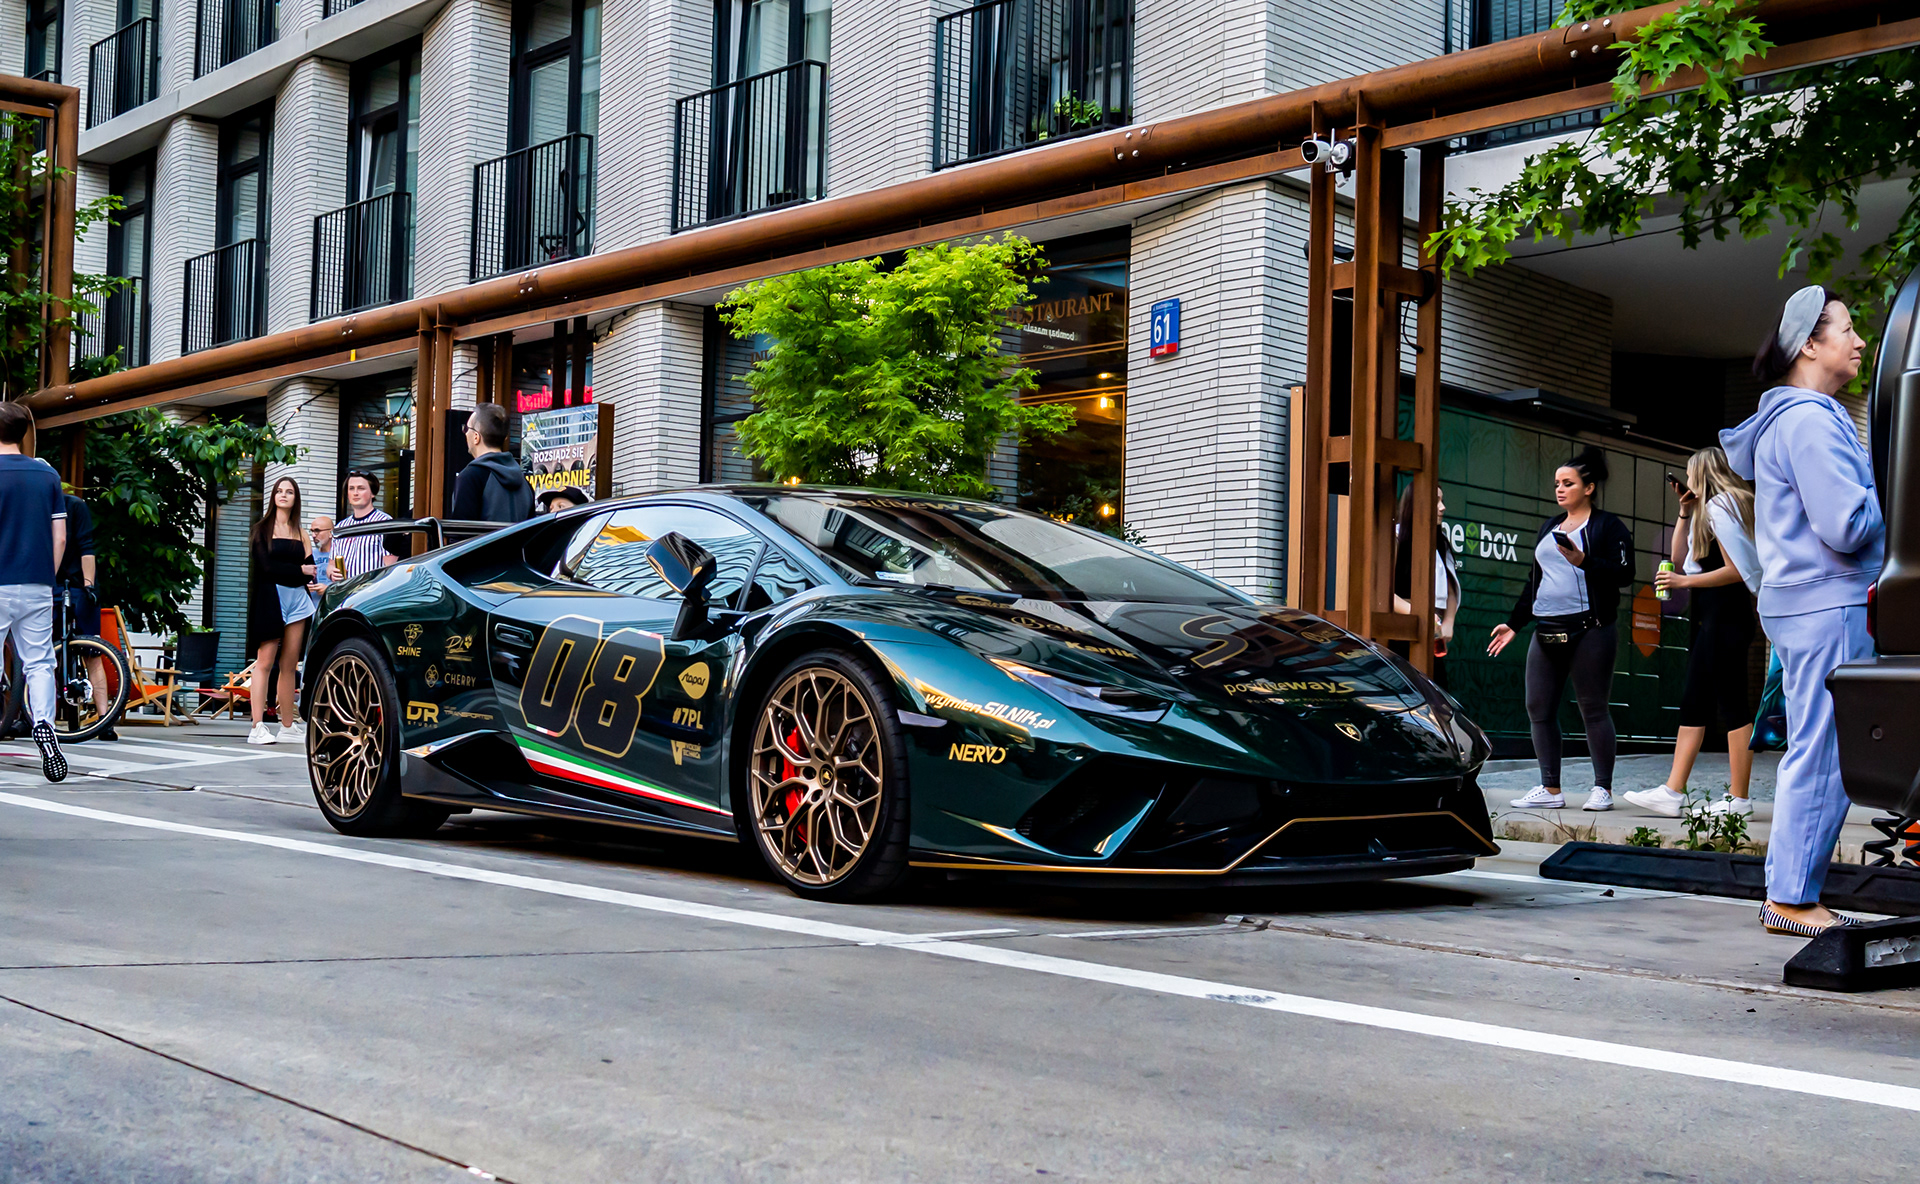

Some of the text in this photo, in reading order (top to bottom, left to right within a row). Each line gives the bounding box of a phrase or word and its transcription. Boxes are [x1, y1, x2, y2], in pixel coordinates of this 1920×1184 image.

[1154, 313, 1170, 343] 61
[534, 446, 584, 464] ROZSIĄDŹ SIĘ
[526, 469, 591, 490] WYGODNIE
[1480, 524, 1518, 561] box
[397, 646, 421, 657] SHINE
[1065, 641, 1139, 660] Karlik
[444, 673, 476, 687] CHERRY
[519, 614, 666, 758] 08
[407, 701, 438, 723] DR
[672, 707, 703, 730] #7PL
